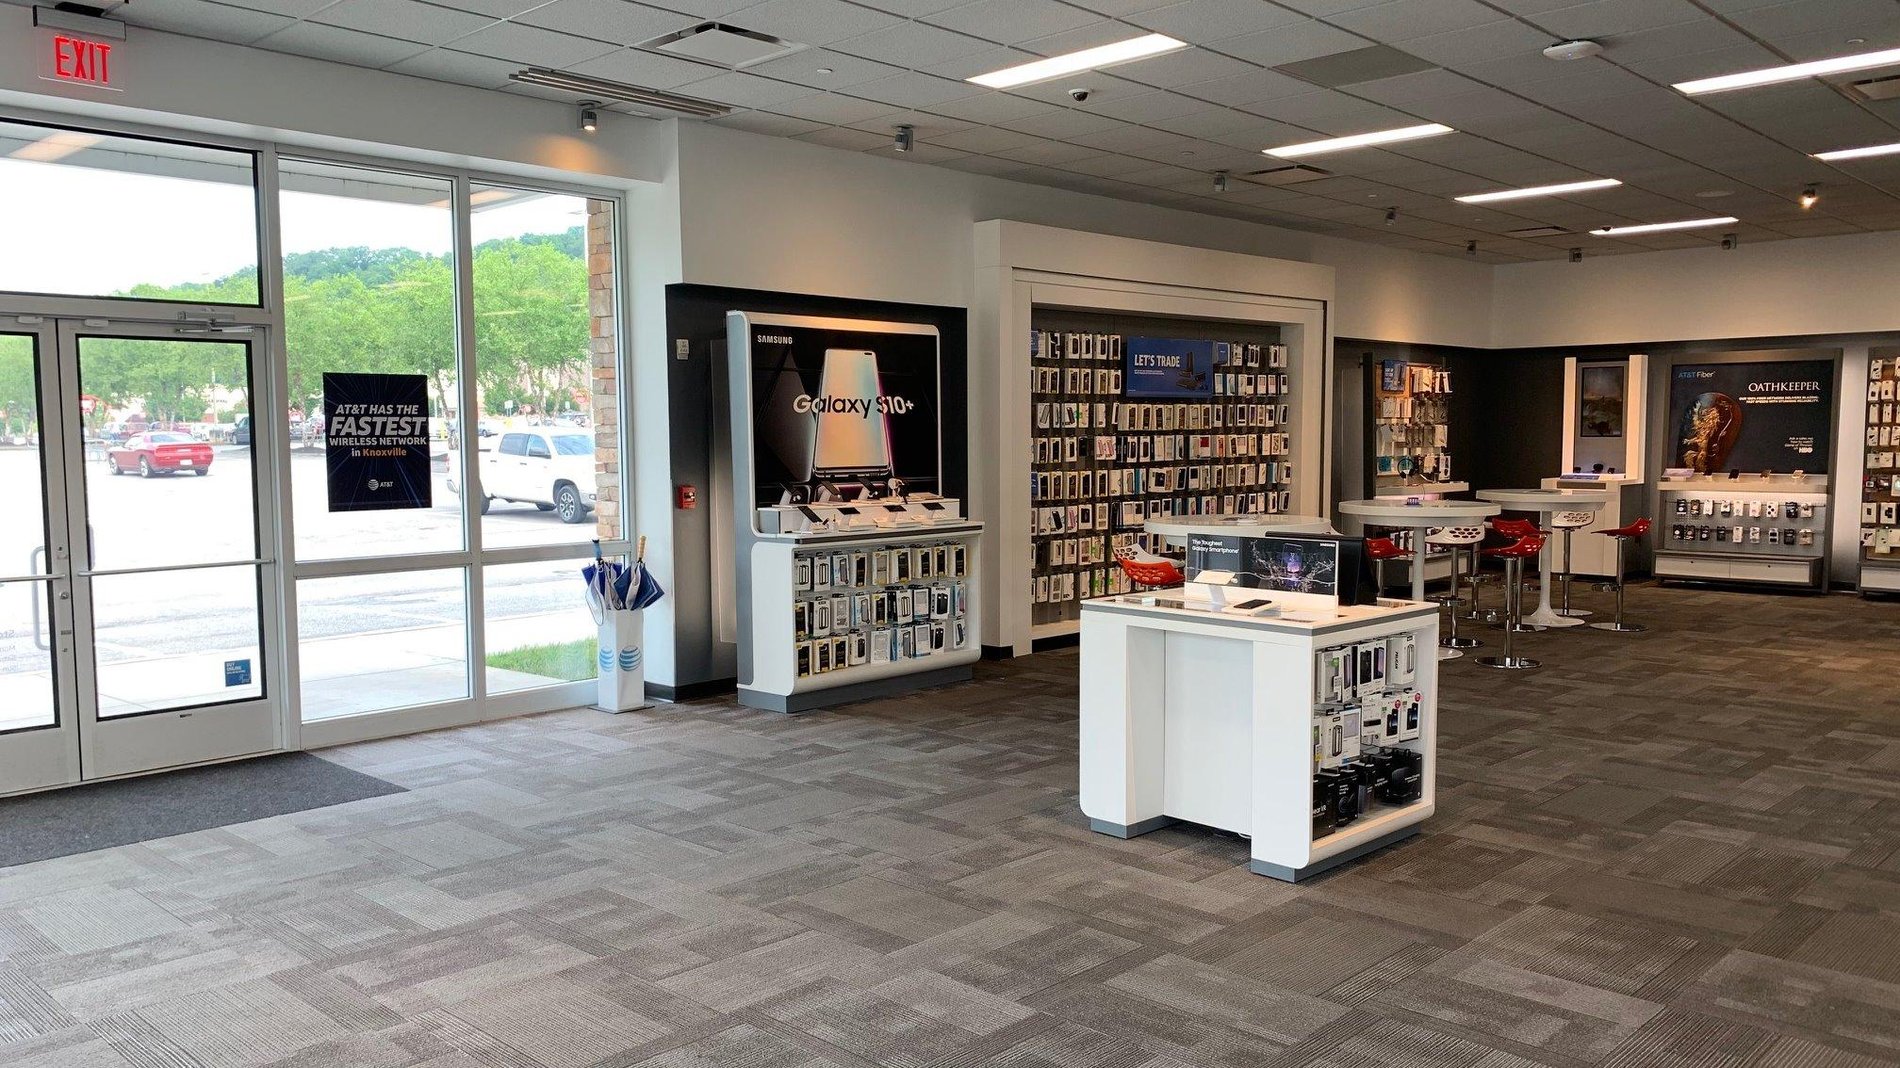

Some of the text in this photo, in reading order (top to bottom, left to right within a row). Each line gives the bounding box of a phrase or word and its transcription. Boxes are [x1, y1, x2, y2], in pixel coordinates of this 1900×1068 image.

[54, 34, 111, 84] EXIT
[757, 335, 793, 345] SAMSUNG
[1134, 354, 1180, 368] LET'S TRADE
[1748, 381, 1821, 392] OATHKEEPER
[335, 404, 419, 415] AT&T HAS THE
[793, 394, 915, 419] Galaxy S10+
[329, 416, 426, 436] FASTEST
[329, 437, 427, 446] WIRELESS NETWORK
[351, 448, 407, 457] in Knoxville
[1191, 545, 1208, 553] Galaxy
